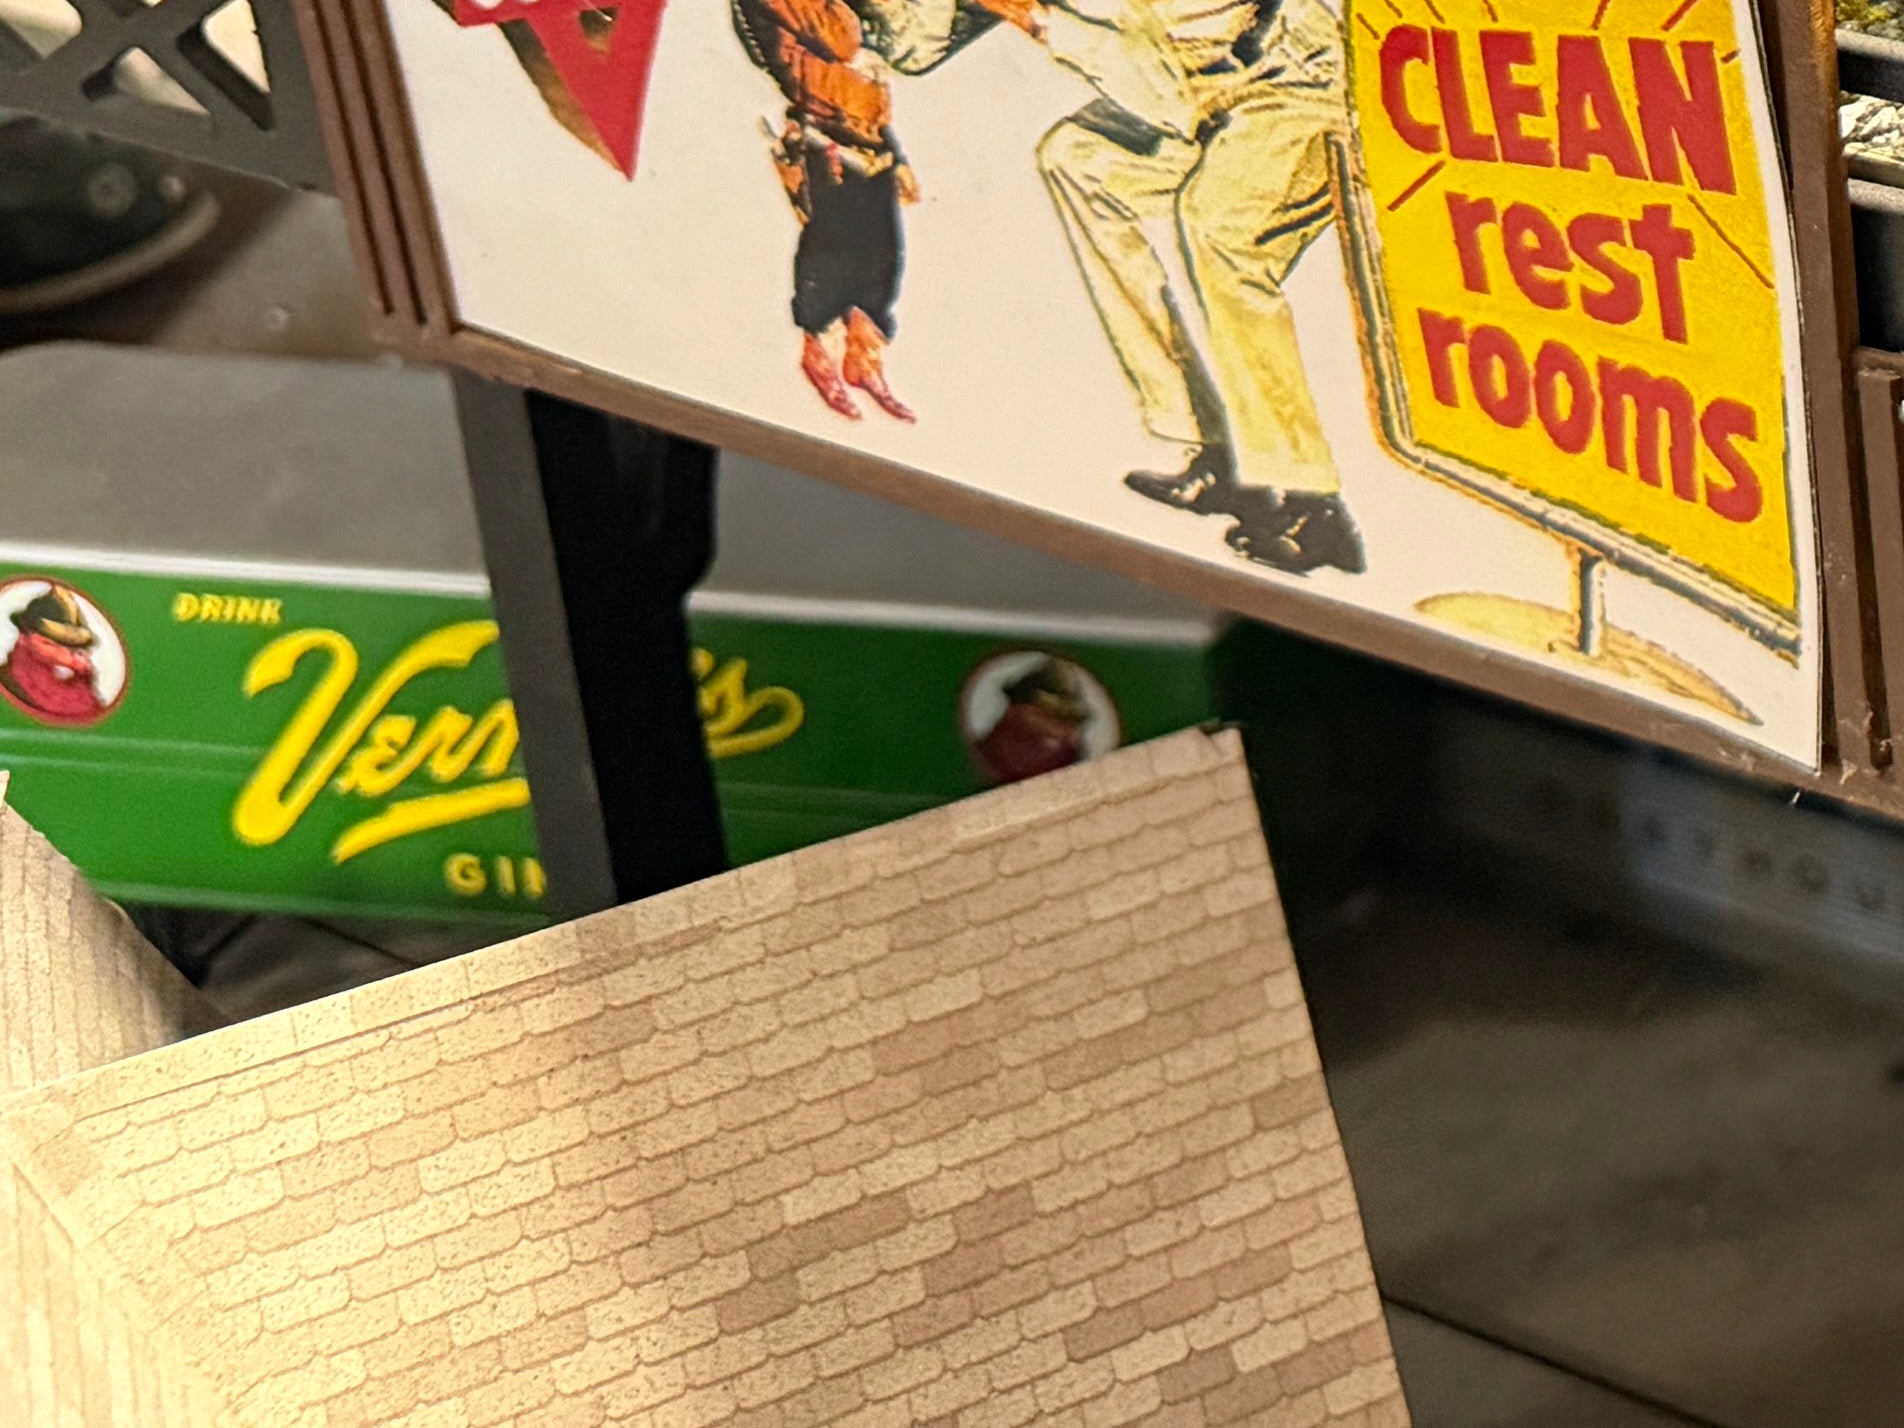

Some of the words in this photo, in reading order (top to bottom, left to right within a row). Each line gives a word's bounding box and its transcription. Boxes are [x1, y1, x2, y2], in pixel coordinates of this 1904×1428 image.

[1379, 25, 1738, 197] CLEAN
[1445, 191, 1695, 344] rest
[1417, 307, 1764, 525] rooms
[171, 591, 284, 625] DRINK
